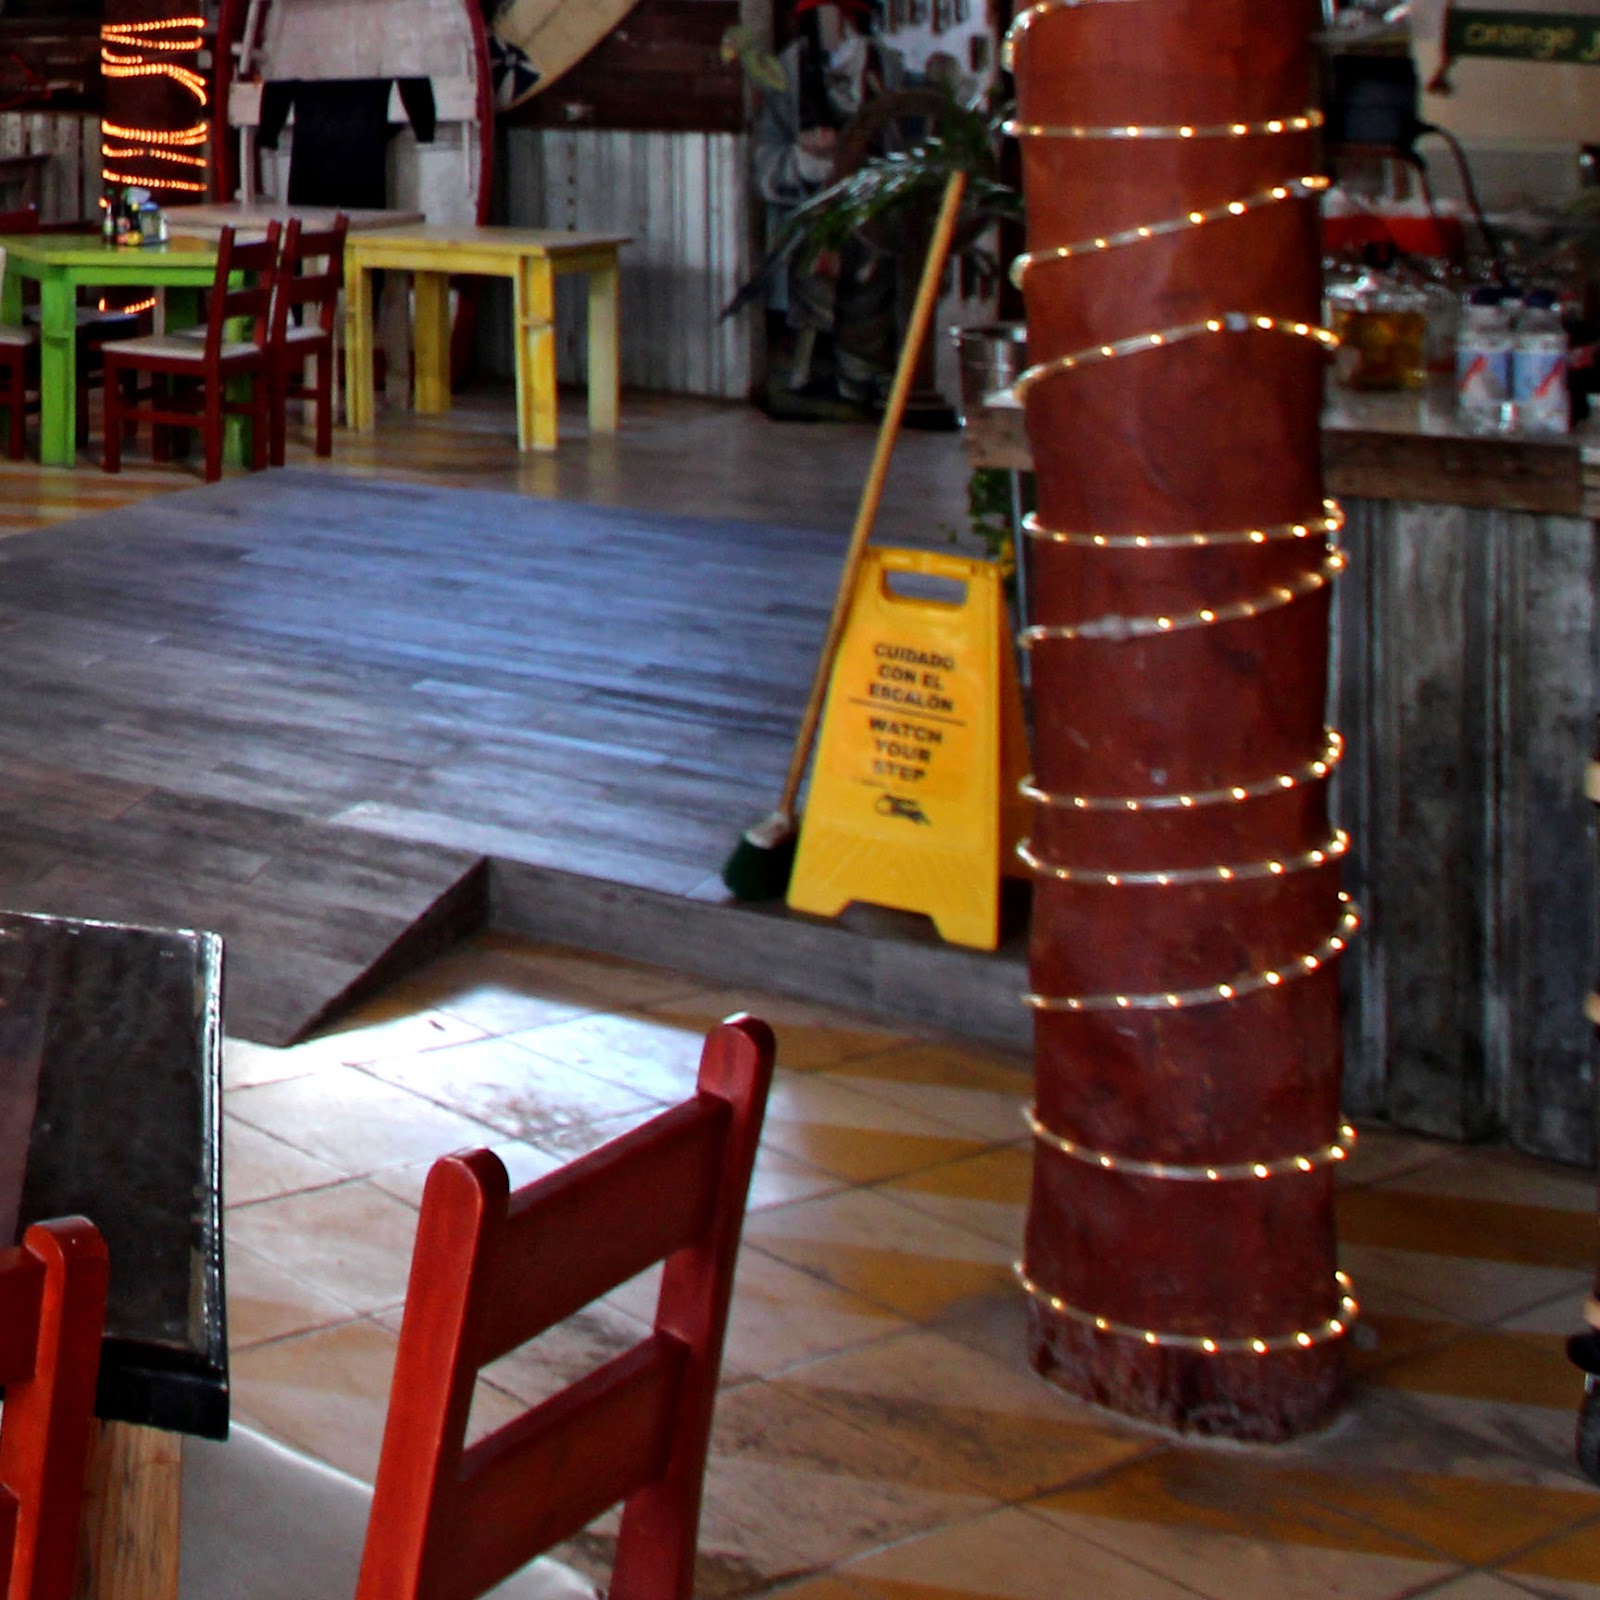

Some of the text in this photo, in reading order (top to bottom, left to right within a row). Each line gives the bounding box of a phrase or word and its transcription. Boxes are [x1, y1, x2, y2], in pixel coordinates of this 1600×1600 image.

[874, 642, 954, 670] CUIDADO
[878, 663, 943, 690] CON EL
[869, 717, 943, 744] WATCH
[876, 739, 931, 763] YOUR
[874, 760, 925, 782] STEP
